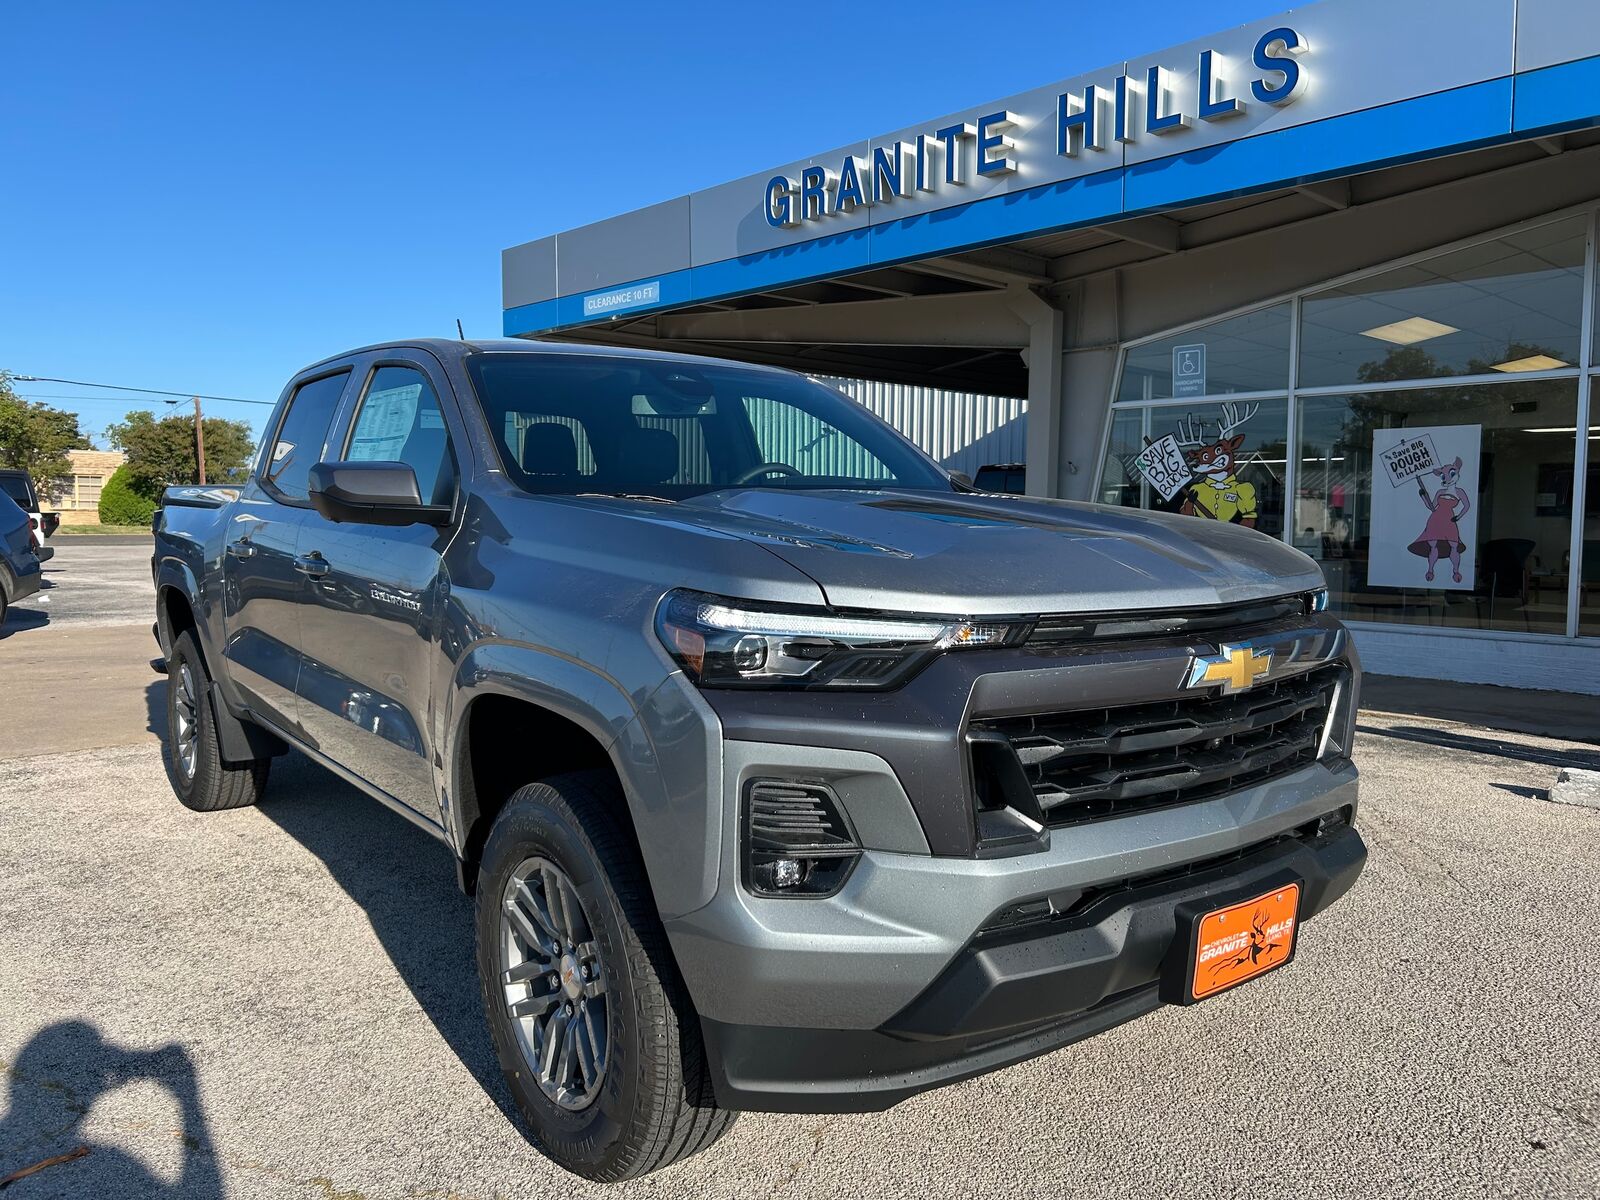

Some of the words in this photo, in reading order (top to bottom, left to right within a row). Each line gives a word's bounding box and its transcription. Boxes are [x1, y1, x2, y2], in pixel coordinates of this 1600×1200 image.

[763, 110, 1018, 229] GRANITE
[1057, 27, 1309, 157] HILLS
[588, 292, 631, 309] CLEARANCE
[633, 290, 642, 300] 10
[643, 287, 653, 299] FT
[1143, 438, 1175, 467] SAVE
[1390, 447, 1430, 472] DOUGH
[1392, 448, 1410, 459] Save
[1411, 440, 1423, 451] BIG
[1148, 453, 1180, 483] BIG
[1404, 458, 1434, 475] LLANO!
[1159, 465, 1191, 497] BUCKS
[1200, 937, 1248, 963] GRANITE
[1266, 918, 1293, 935] HILLS
[1210, 934, 1240, 948] CHEVROLET
